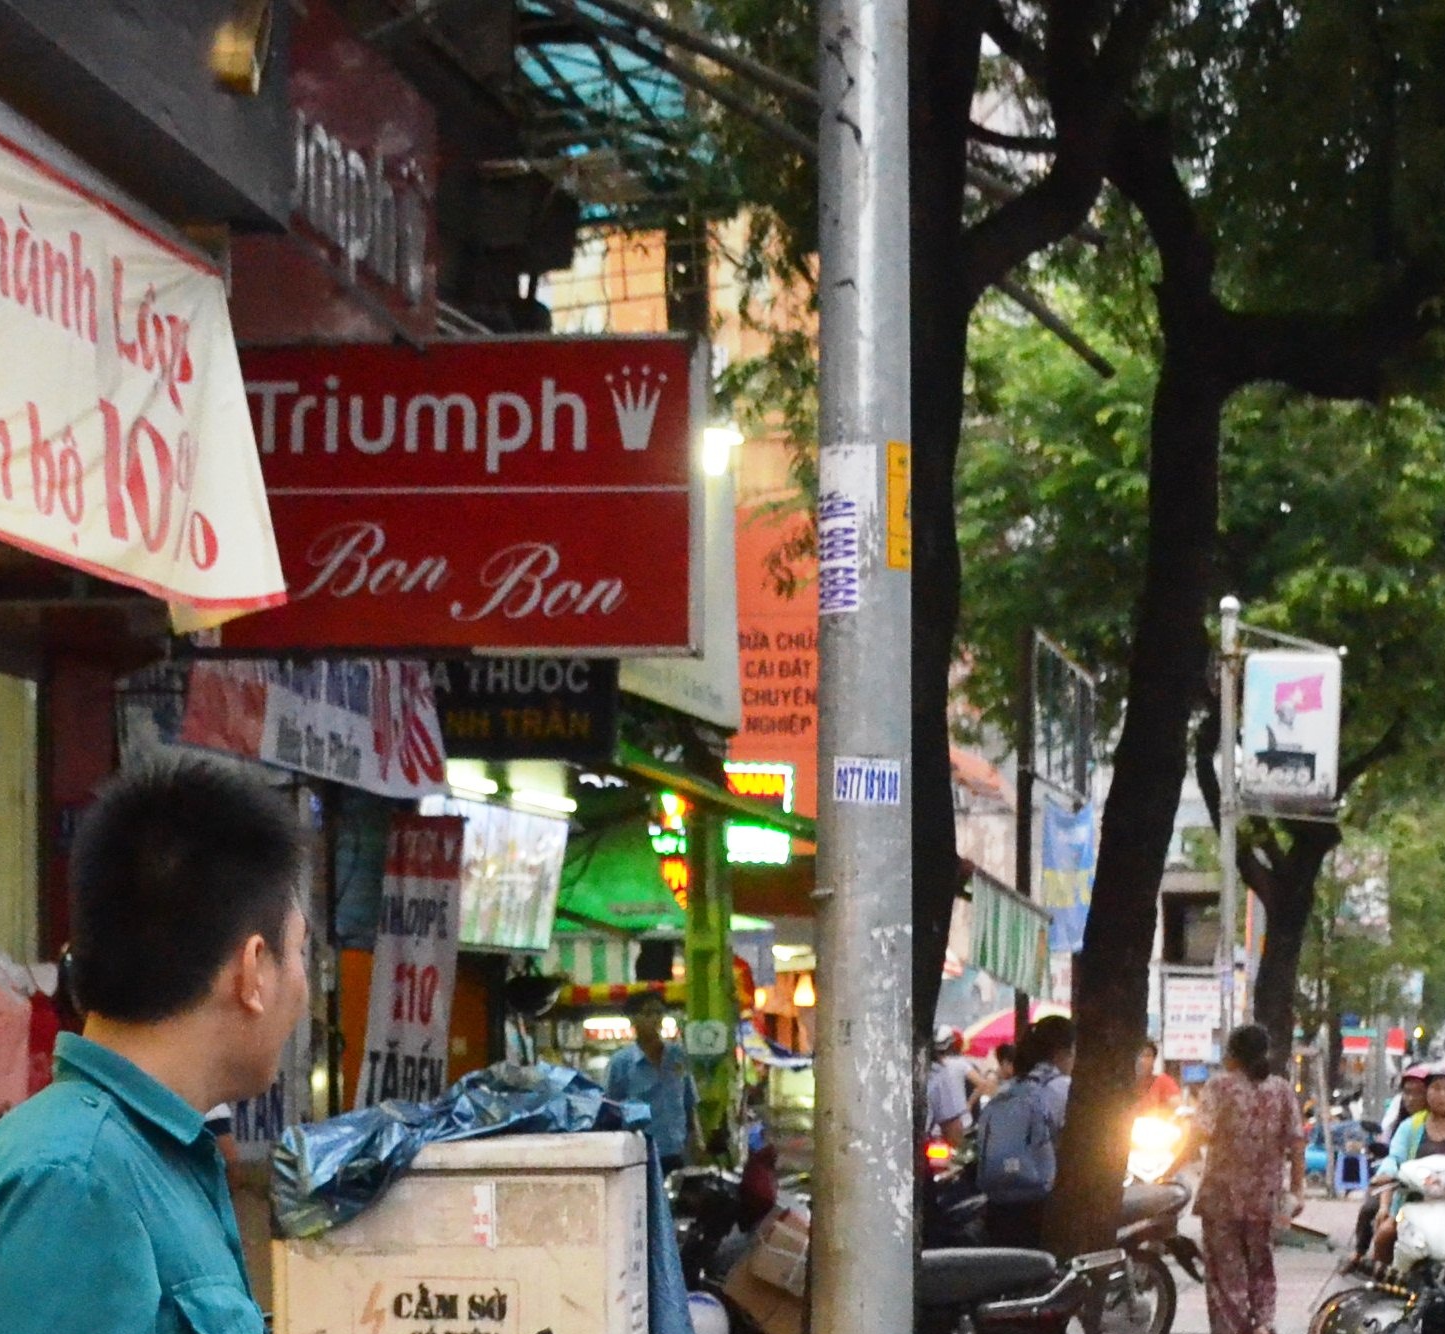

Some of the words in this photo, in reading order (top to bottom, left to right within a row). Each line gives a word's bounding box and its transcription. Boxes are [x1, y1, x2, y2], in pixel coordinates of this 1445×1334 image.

[244, 374, 588, 474] Triumph
[27, 401, 85, 547] bộ
[99, 397, 219, 571] 10%
[294, 520, 449, 601] Bon
[449, 541, 626, 622] Bon
